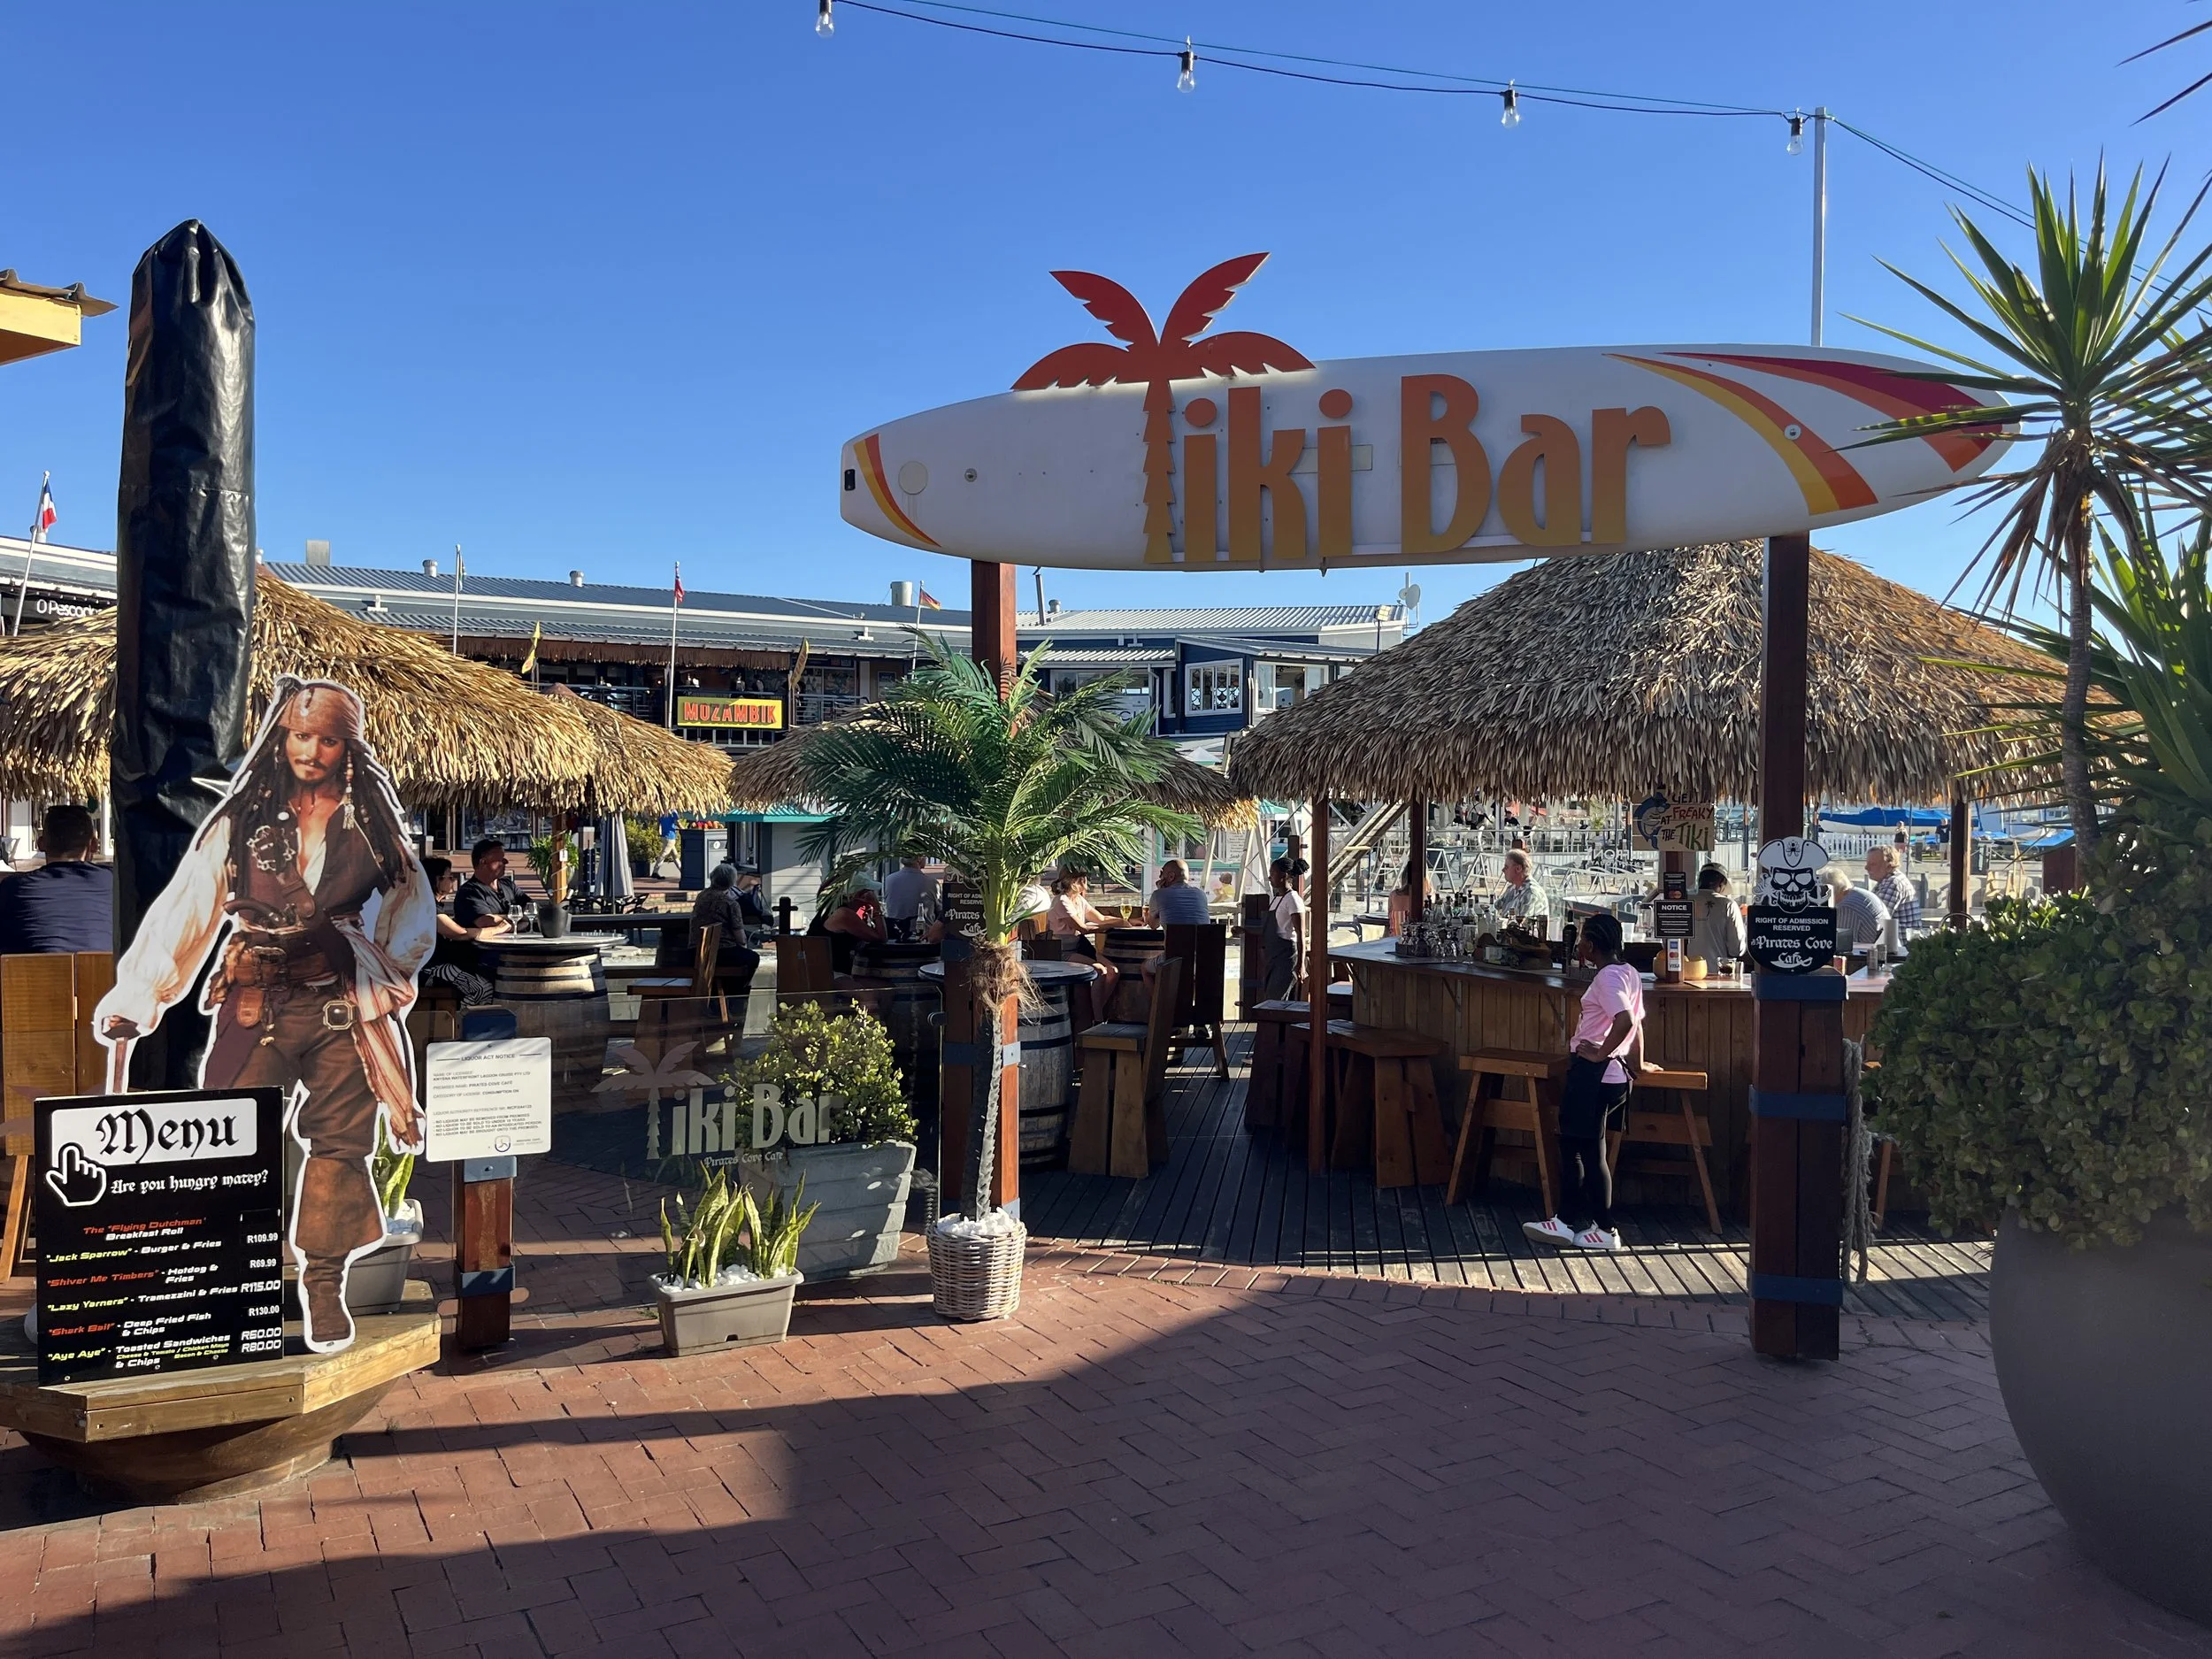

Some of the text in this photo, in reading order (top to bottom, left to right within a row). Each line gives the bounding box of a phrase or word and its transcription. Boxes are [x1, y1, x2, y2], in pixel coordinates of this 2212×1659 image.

[1402, 374, 1671, 554] Bar
[36, 599, 48, 614] O
[684, 702, 777, 724] MOZAMBIK
[1660, 815, 1672, 825] AT
[1672, 805, 1714, 820] FREAKY
[1661, 828, 1676, 841] THE
[1756, 935, 1801, 949] Pirates
[1805, 936, 1833, 949] Cove
[1778, 952, 1802, 964] Cafe
[752, 1083, 844, 1149] Bar
[96, 1108, 239, 1164] Menu
[703, 1156, 739, 1168] Pirates
[741, 1153, 763, 1164] Cove
[111, 1169, 269, 1194] Are you hungry matey?
[105, 1226, 184, 1241] Breakfast Roll
[247, 1232, 279, 1244] R109.99
[141, 1245, 180, 1254] Burger
[193, 1240, 222, 1249] Fries
[250, 1257, 277, 1269] R69.99
[90, 1275, 109, 1284] Me
[167, 1265, 208, 1276] Hotdog
[165, 1275, 195, 1284] Fries
[240, 1279, 281, 1293] R115.00
[138, 1289, 196, 1303] Tramezzini
[210, 1286, 238, 1295] Fries
[249, 1304, 280, 1317] R130.00
[124, 1319, 153, 1329] Deep
[156, 1315, 185, 1325] Fried
[187, 1312, 211, 1322] Fish
[134, 1325, 165, 1336] Chips
[115, 1341, 161, 1354] Toasted
[163, 1334, 231, 1348] Sandwiches
[115, 1357, 161, 1369] & Chips
